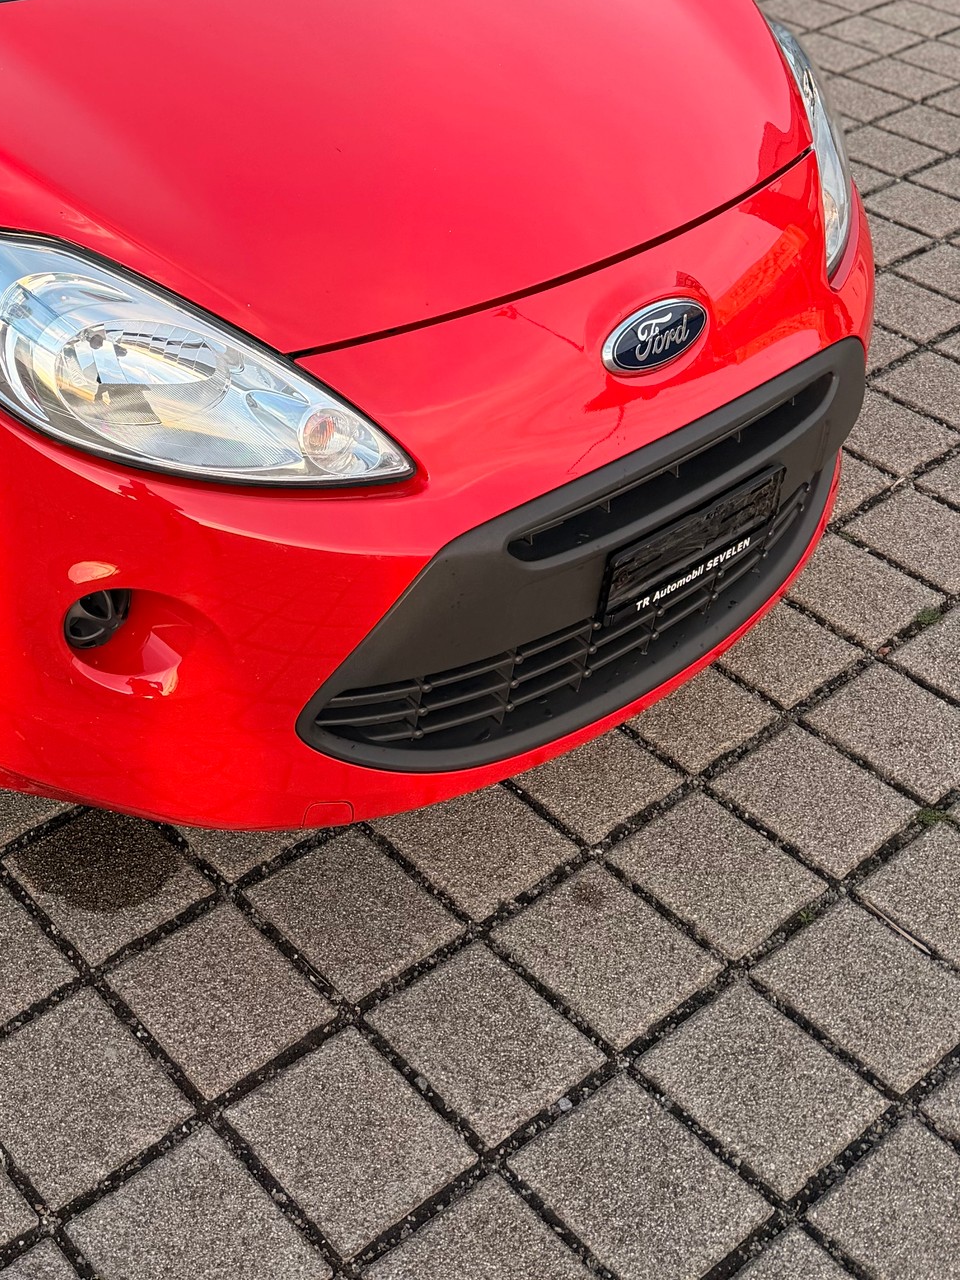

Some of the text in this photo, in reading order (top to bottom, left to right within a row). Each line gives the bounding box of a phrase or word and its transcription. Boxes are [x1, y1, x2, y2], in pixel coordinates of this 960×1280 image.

[635, 312, 690, 362] Ford
[635, 536, 751, 612] TR Automobil SEVELEN
